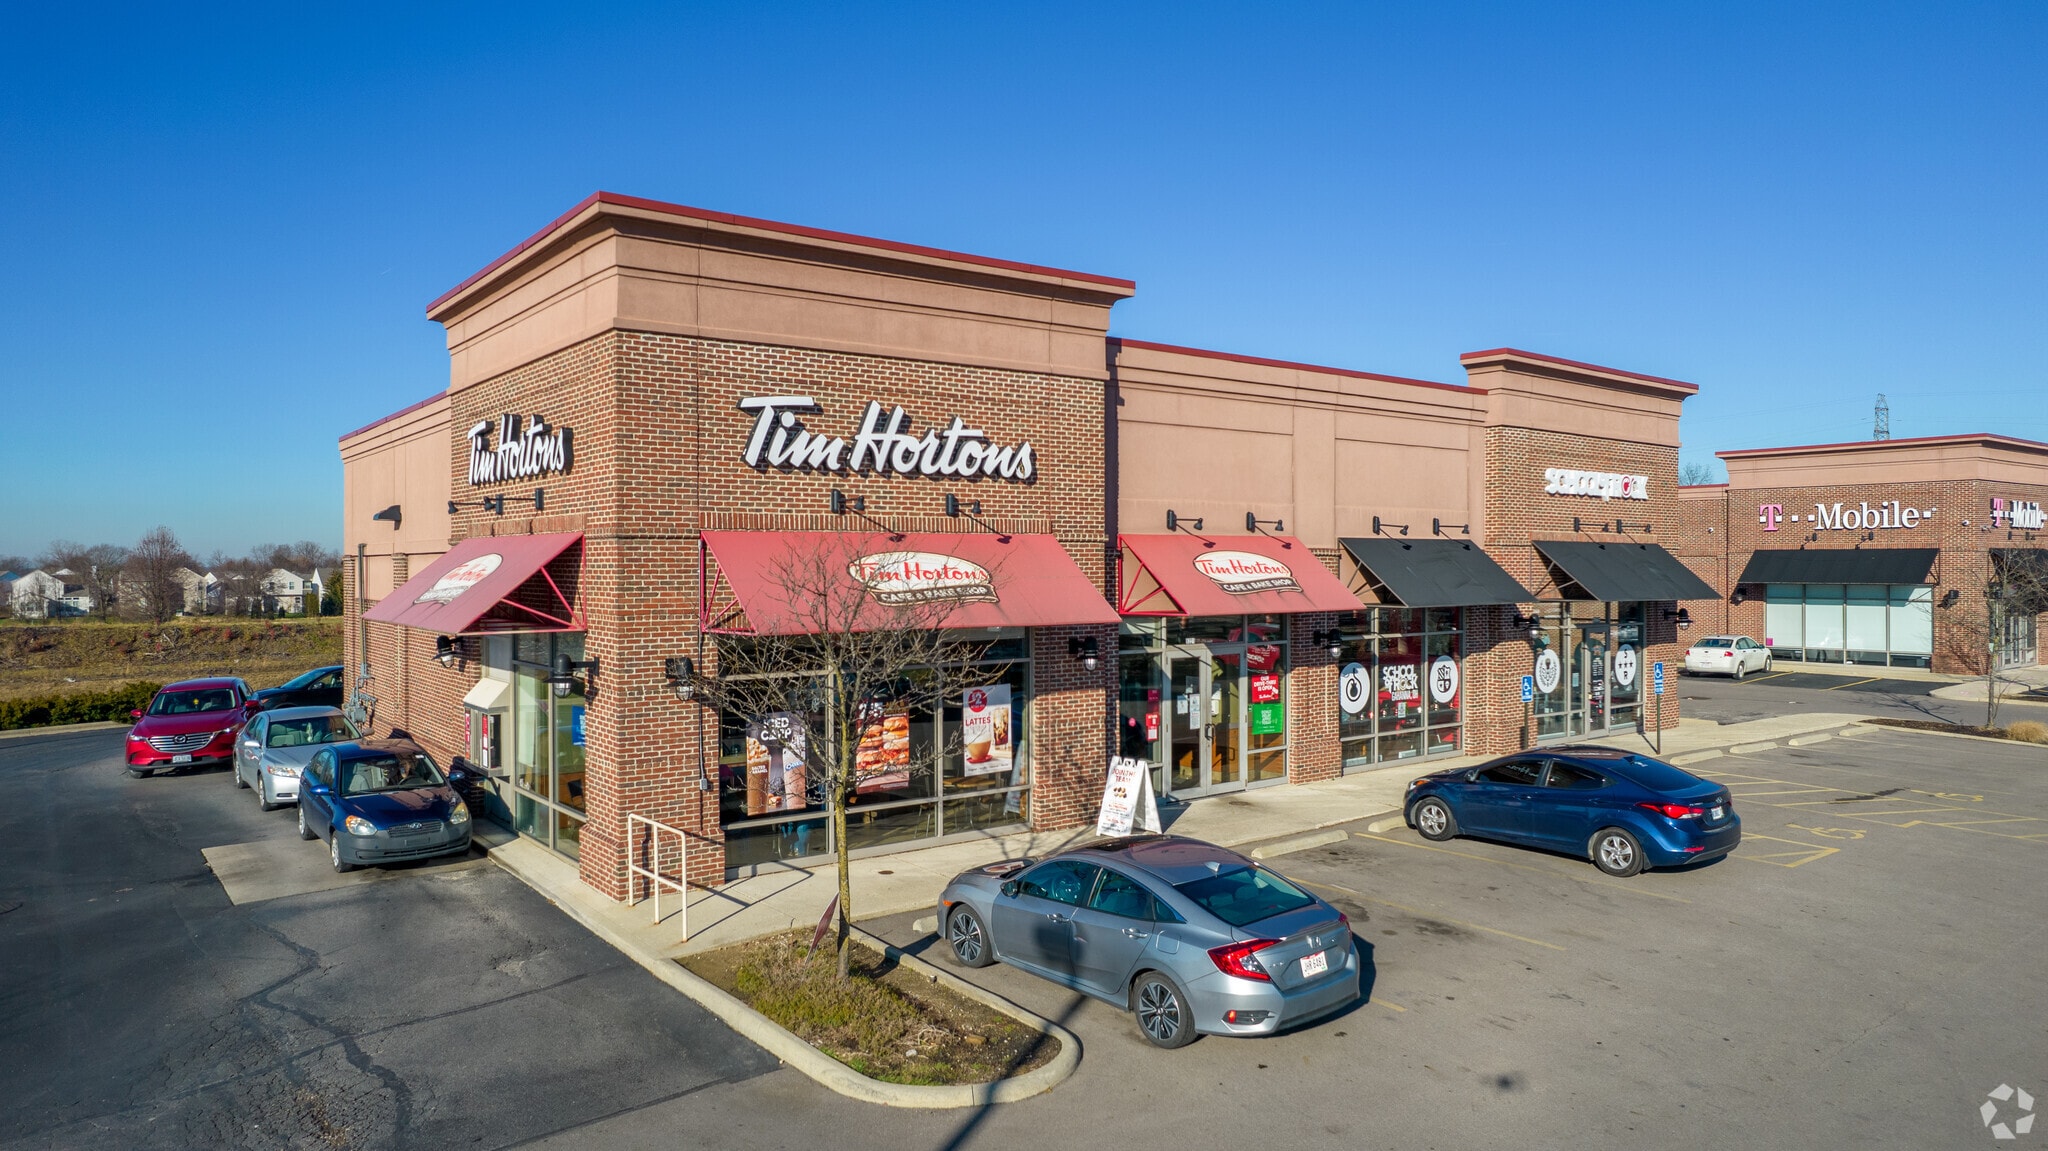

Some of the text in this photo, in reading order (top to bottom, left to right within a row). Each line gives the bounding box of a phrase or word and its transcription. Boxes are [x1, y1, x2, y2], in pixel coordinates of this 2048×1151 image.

[740, 396, 1031, 479] Tim Hortons
[467, 414, 565, 486] Tim Hortons
[850, 561, 988, 581] Tim Hortons
[1195, 559, 1290, 575] Tim Hortons
[1251, 580, 1272, 589] BAKE
[1270, 579, 1293, 587] SHOP
[924, 588, 957, 598] BAKE
[1382, 664, 1415, 680] SCHOOL
[1393, 673, 1418, 691] ROCK
[965, 716, 991, 727] LATTES
